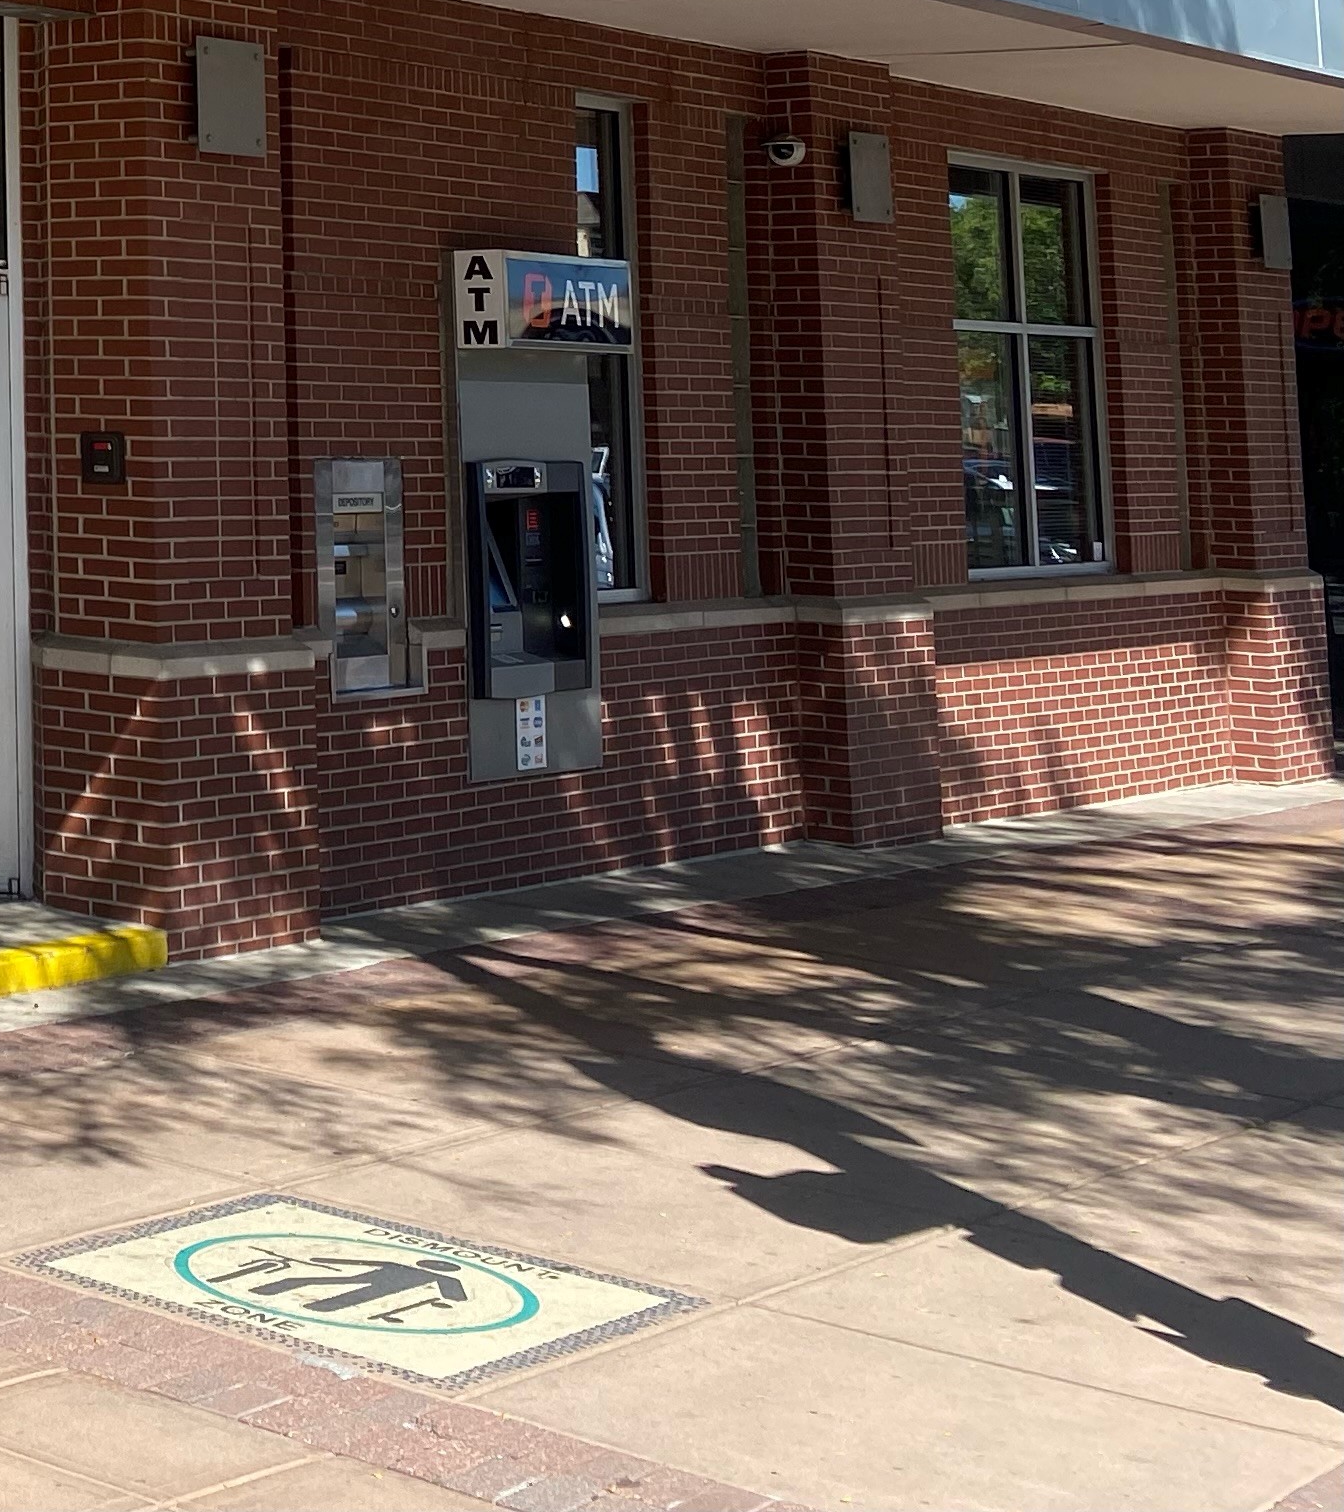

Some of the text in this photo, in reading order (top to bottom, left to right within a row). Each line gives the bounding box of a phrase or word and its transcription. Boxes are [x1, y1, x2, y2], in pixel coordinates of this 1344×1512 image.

[464, 255, 499, 345] ATM
[561, 279, 620, 329] ATM
[338, 497, 374, 507] DEPOSITORY
[363, 1227, 561, 1280] DISMOUNT
[193, 1299, 305, 1331] ZONE
